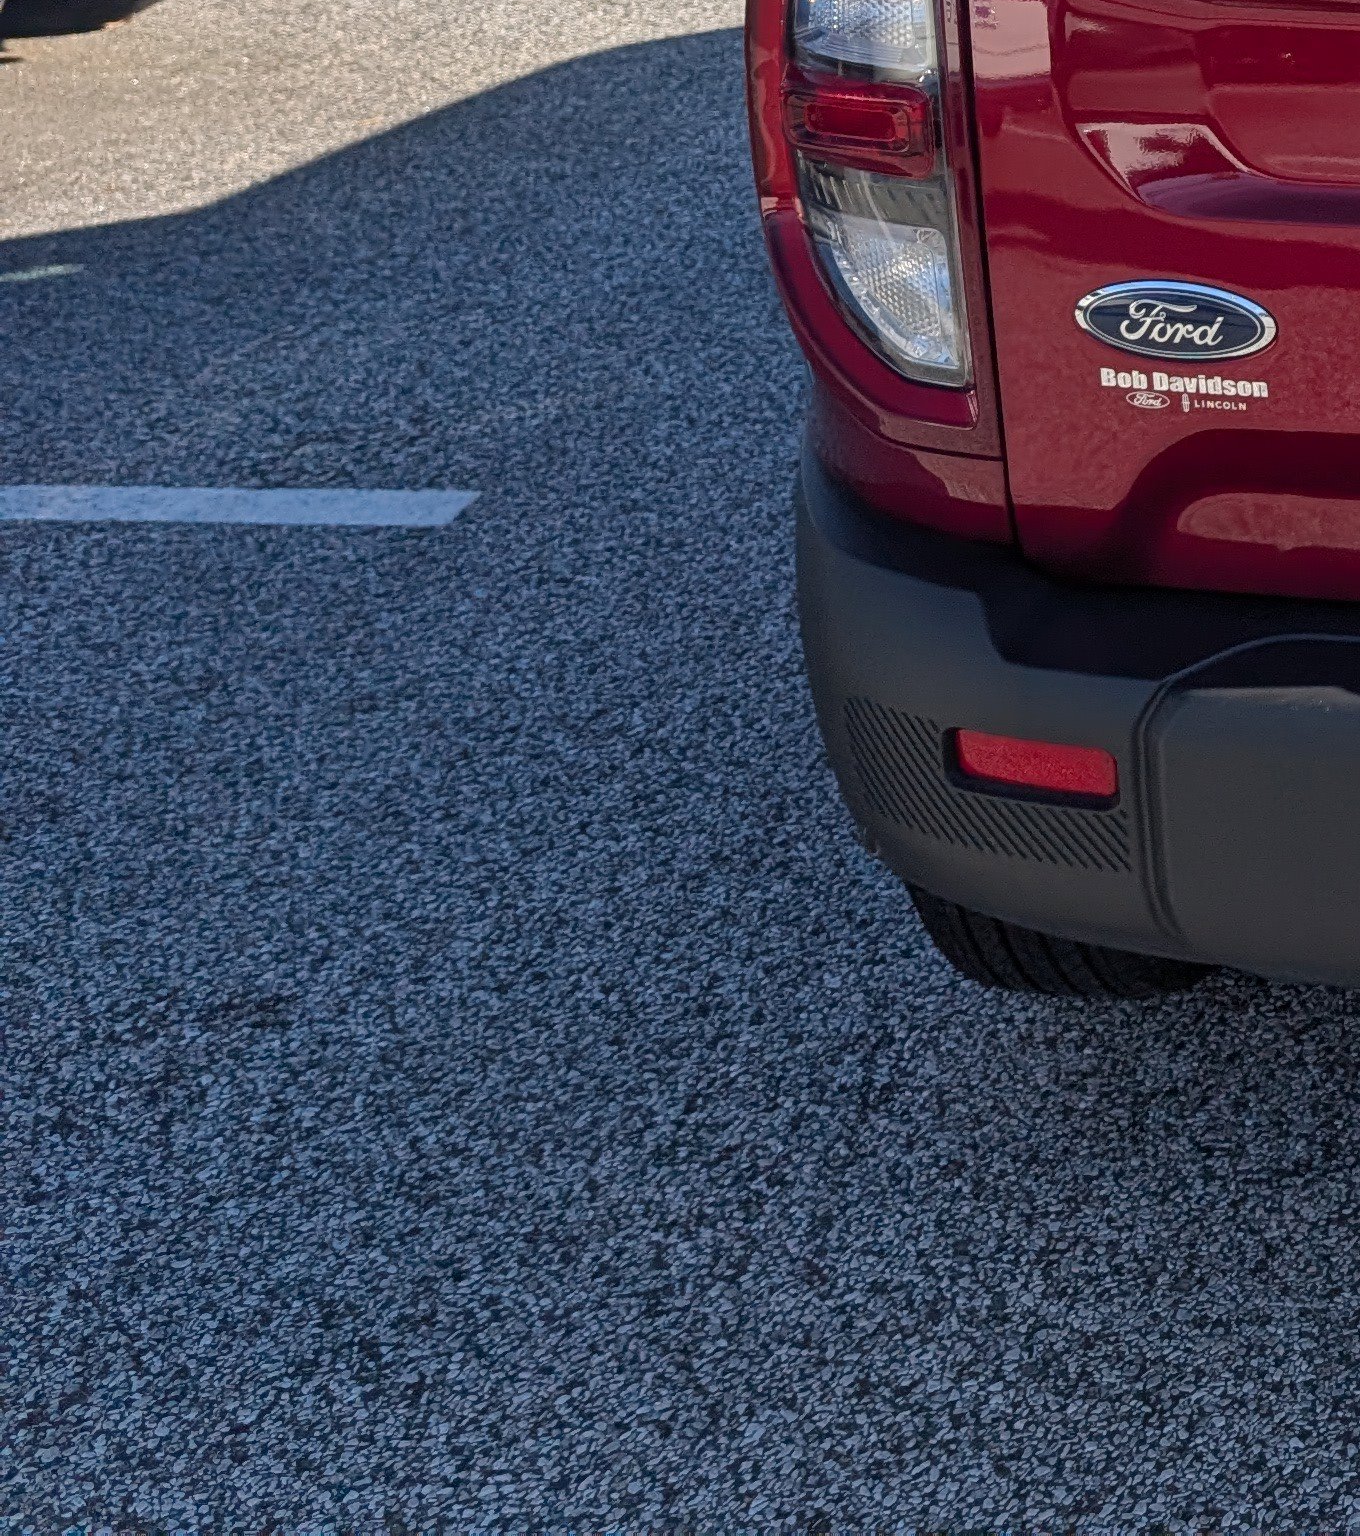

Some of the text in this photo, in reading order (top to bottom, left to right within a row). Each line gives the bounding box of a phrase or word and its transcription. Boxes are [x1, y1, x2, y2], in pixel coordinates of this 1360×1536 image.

[1119, 298, 1225, 347] Ford
[1100, 367, 1269, 398] Bob Davidson
[1194, 400, 1247, 411] LINCOLN
